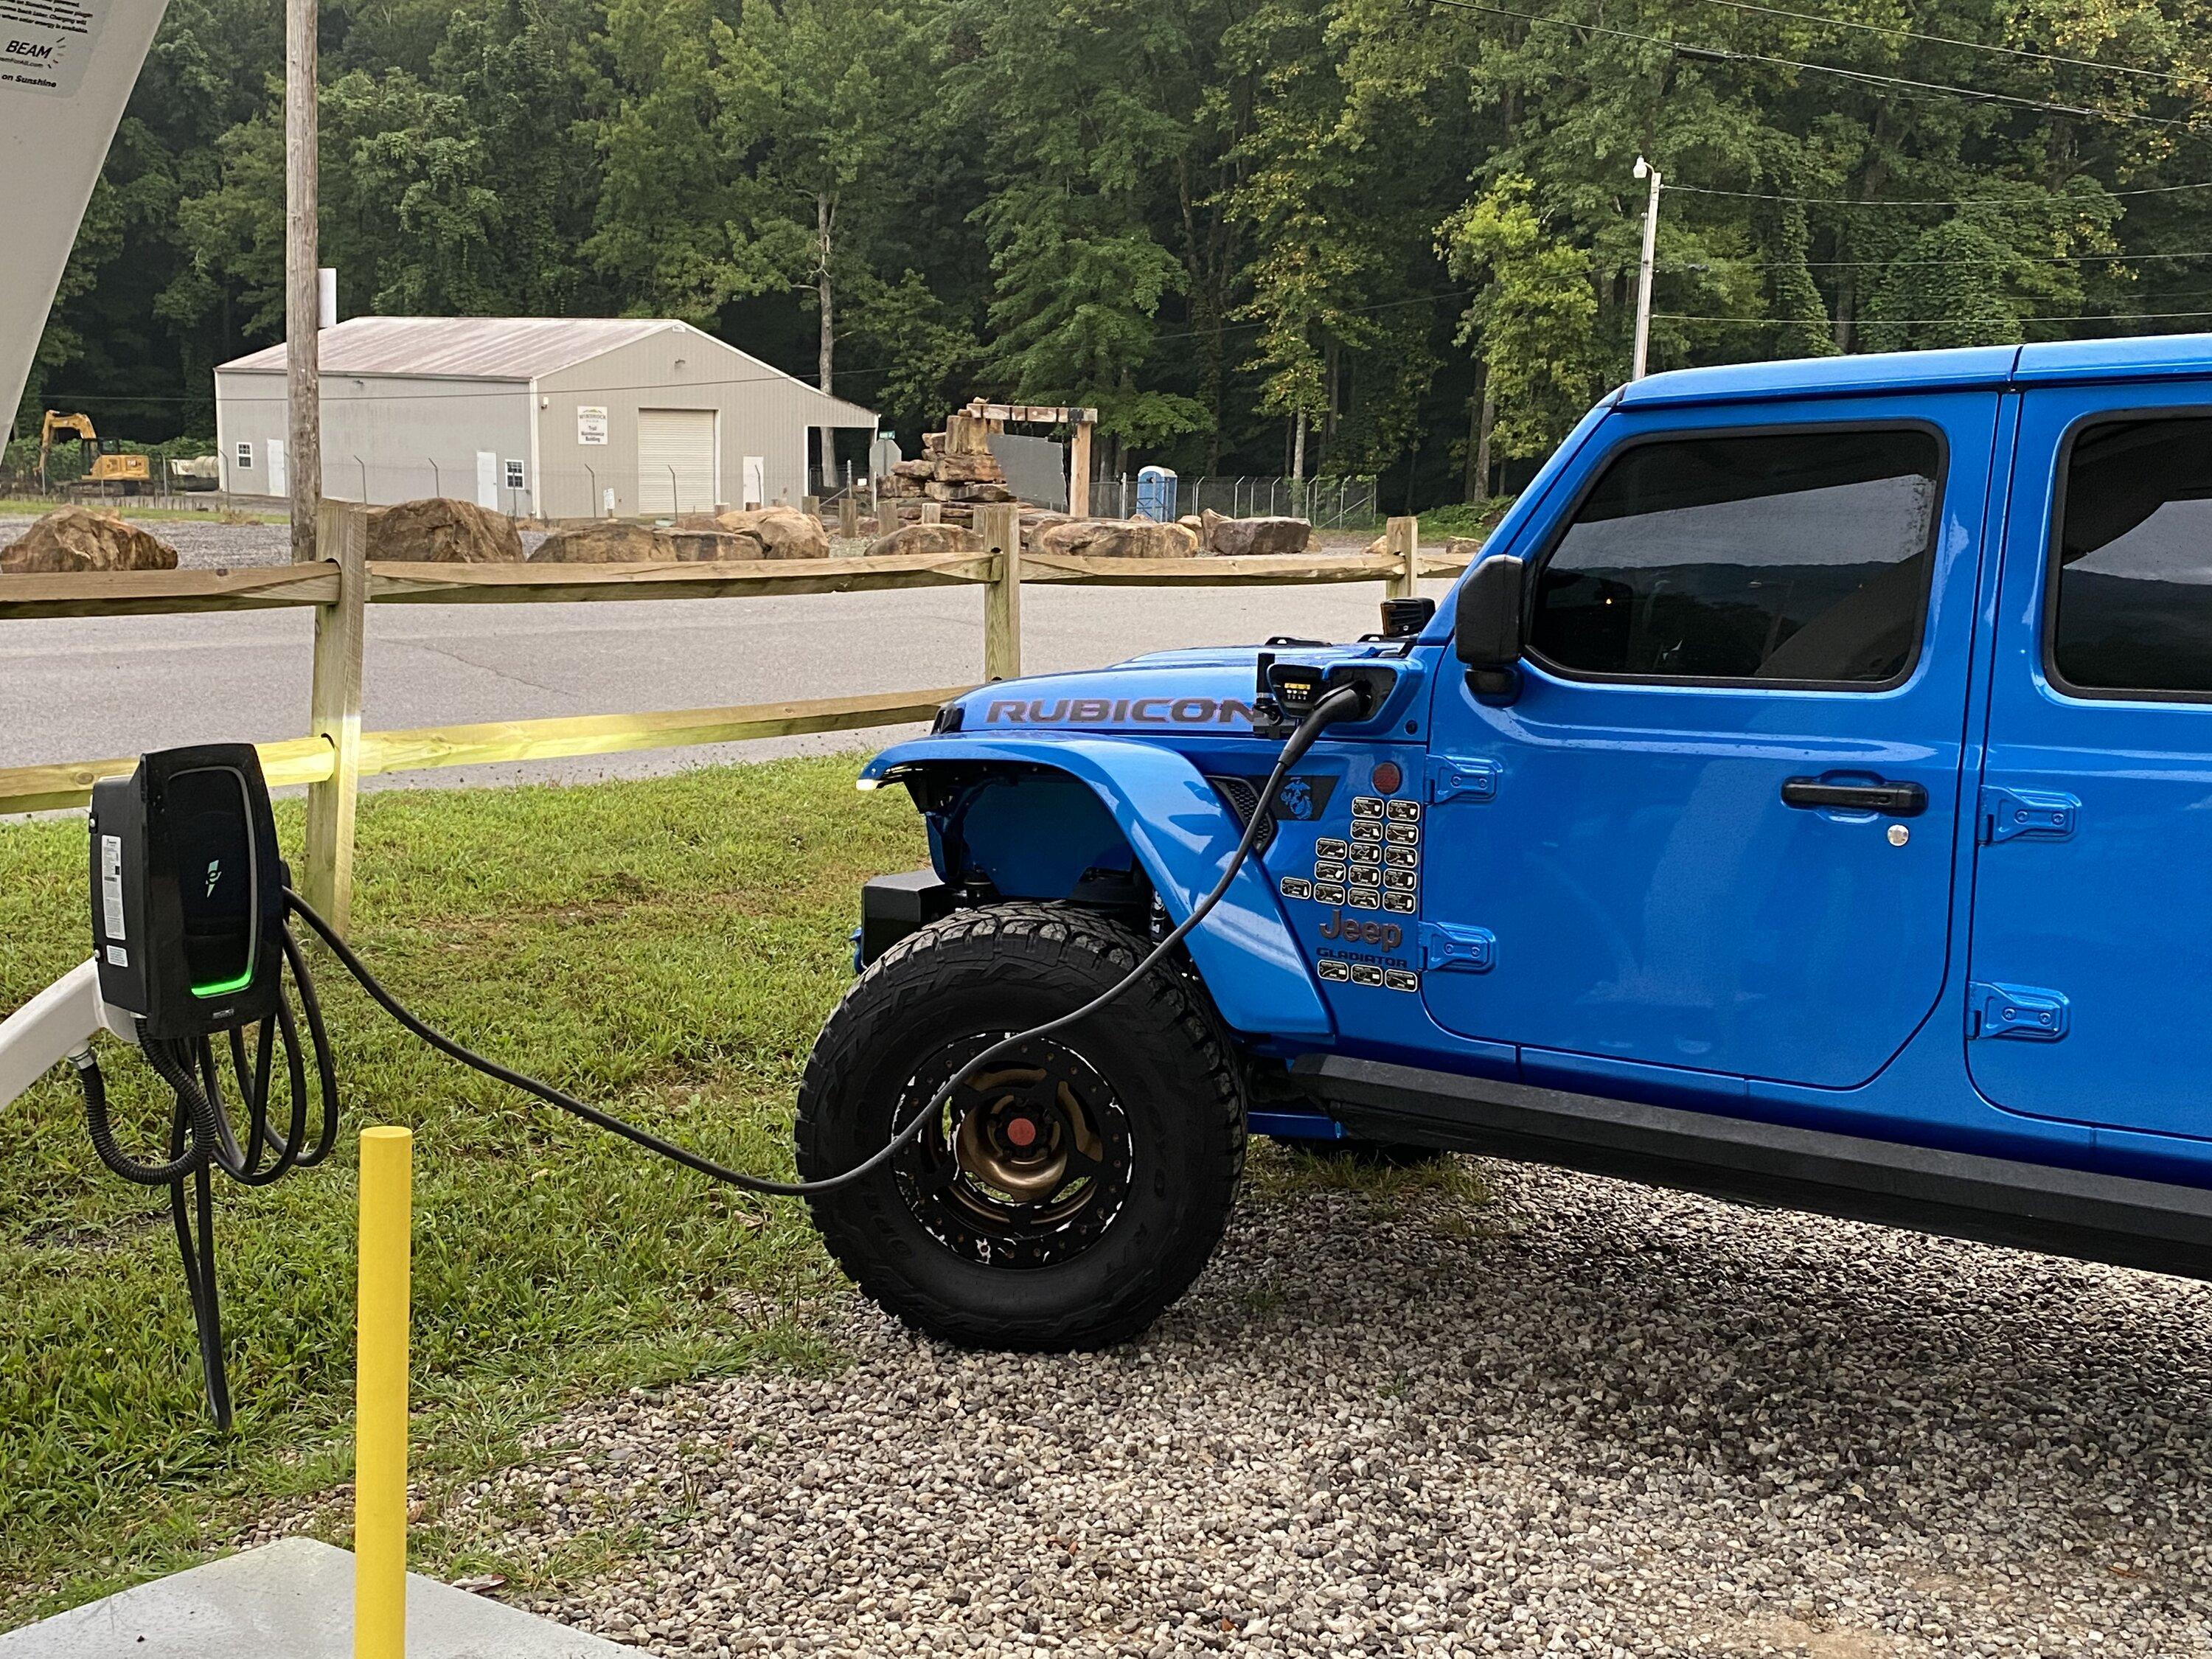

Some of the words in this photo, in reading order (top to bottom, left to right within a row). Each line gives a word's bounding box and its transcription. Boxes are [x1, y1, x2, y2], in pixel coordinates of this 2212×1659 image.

[35, 21, 55, 29] energy
[6, 40, 53, 59] BEAM
[15, 75, 57, 88] Sunshine
[985, 698, 1255, 725] RUBICON
[1319, 908, 1402, 953] Jeep
[1316, 947, 1408, 968] GLADIATOR
